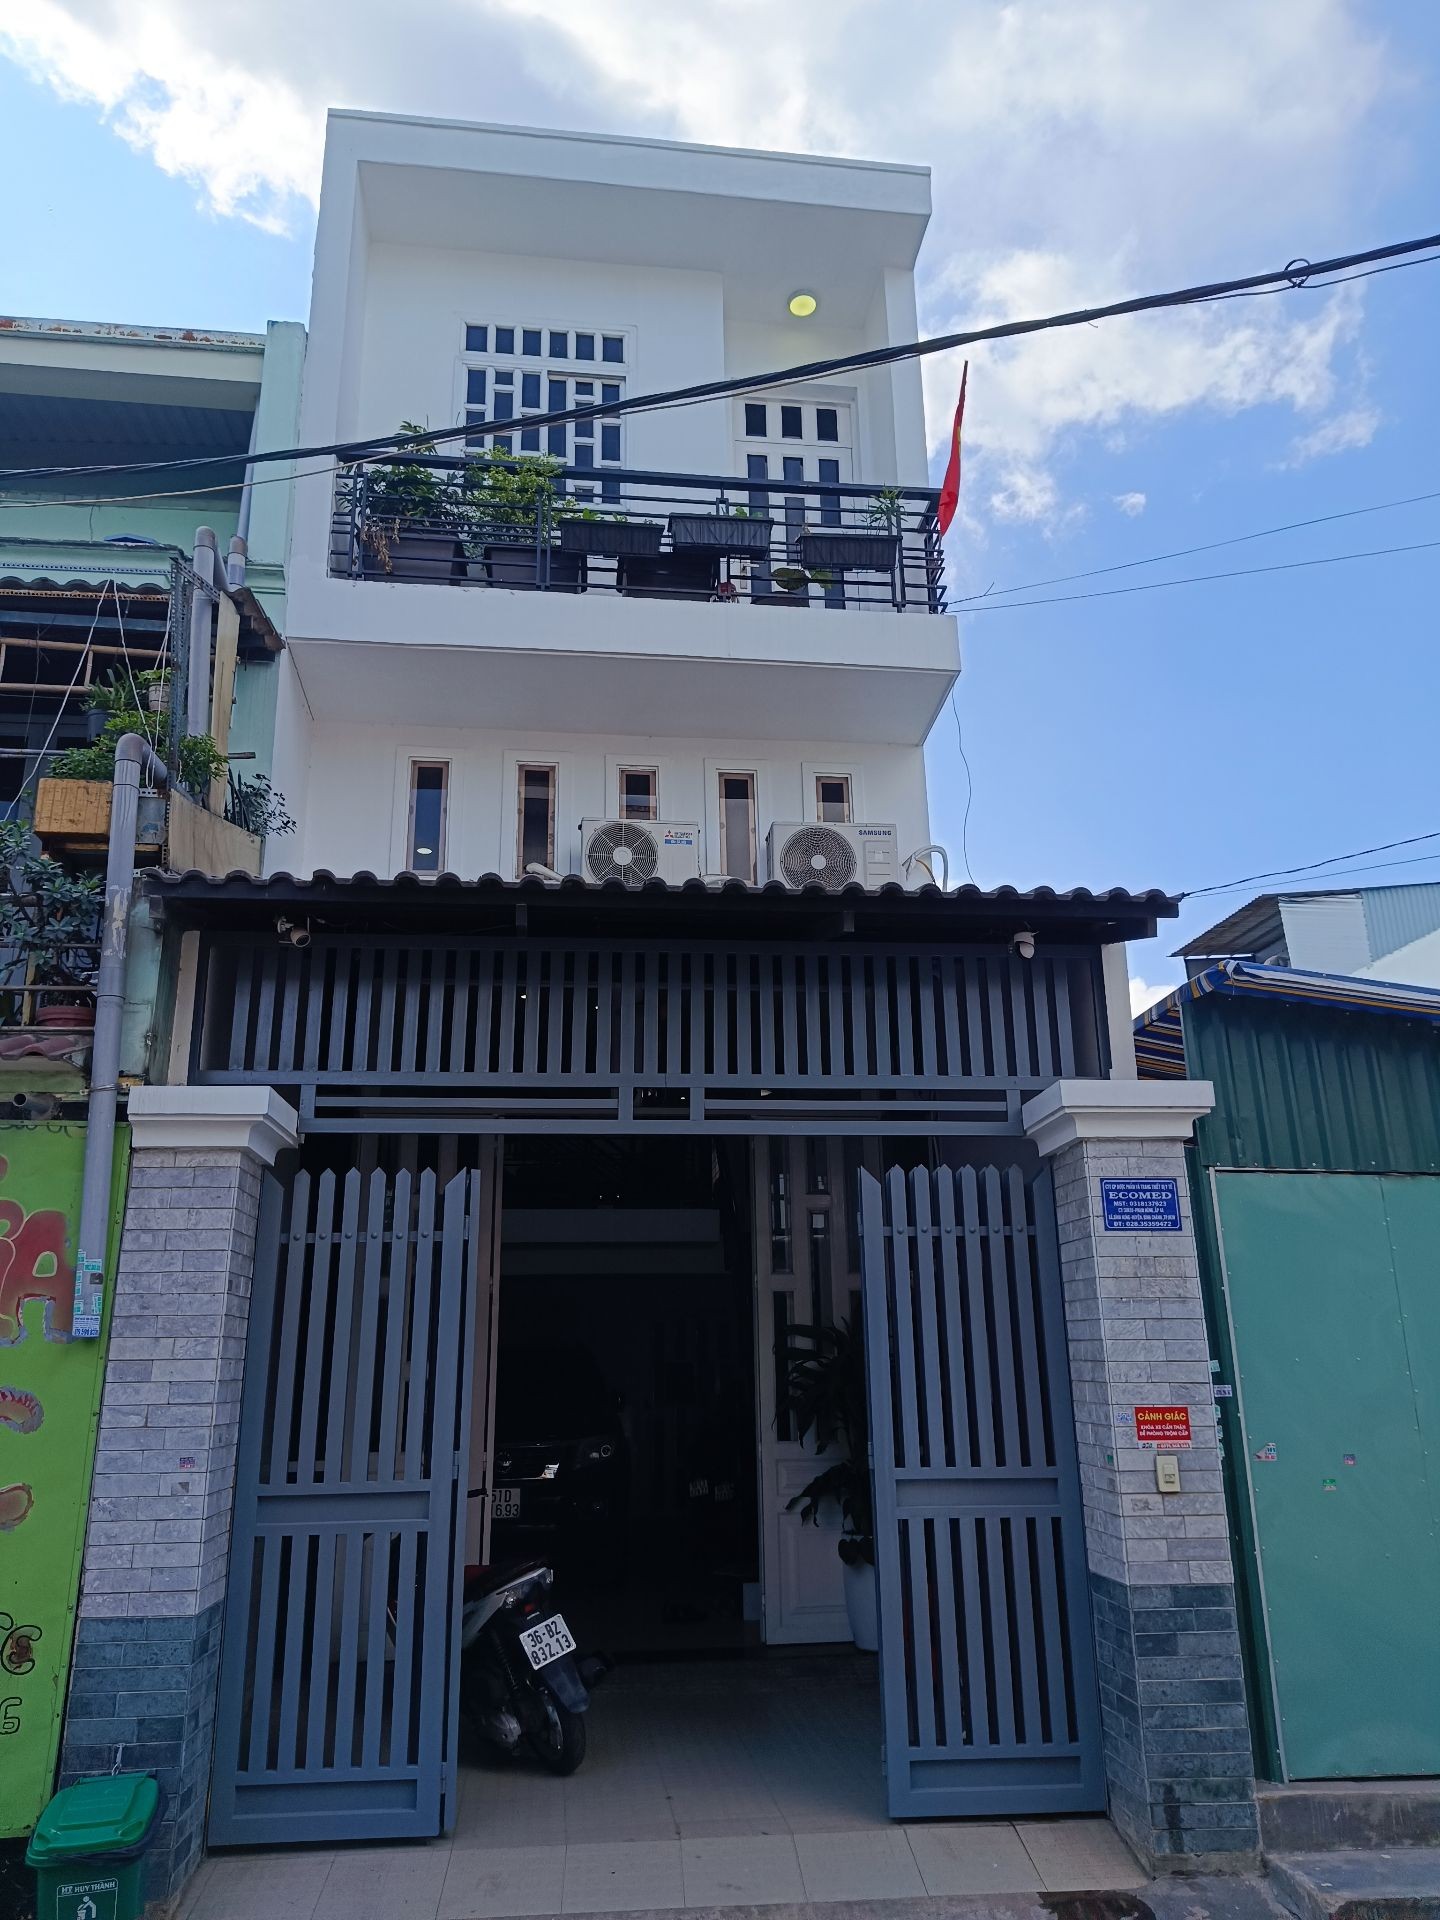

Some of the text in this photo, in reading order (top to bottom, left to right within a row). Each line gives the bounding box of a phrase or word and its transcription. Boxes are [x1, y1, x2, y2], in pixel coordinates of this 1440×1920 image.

[1108, 1191, 1172, 1199] ECOMED
[1137, 1410, 1162, 1421] CẢNH
[1164, 1410, 1186, 1421] GIÁC
[493, 1504, 519, 1516] 6.93
[531, 1634, 571, 1665] 832.13
[74, 1884, 90, 1893] HUY
